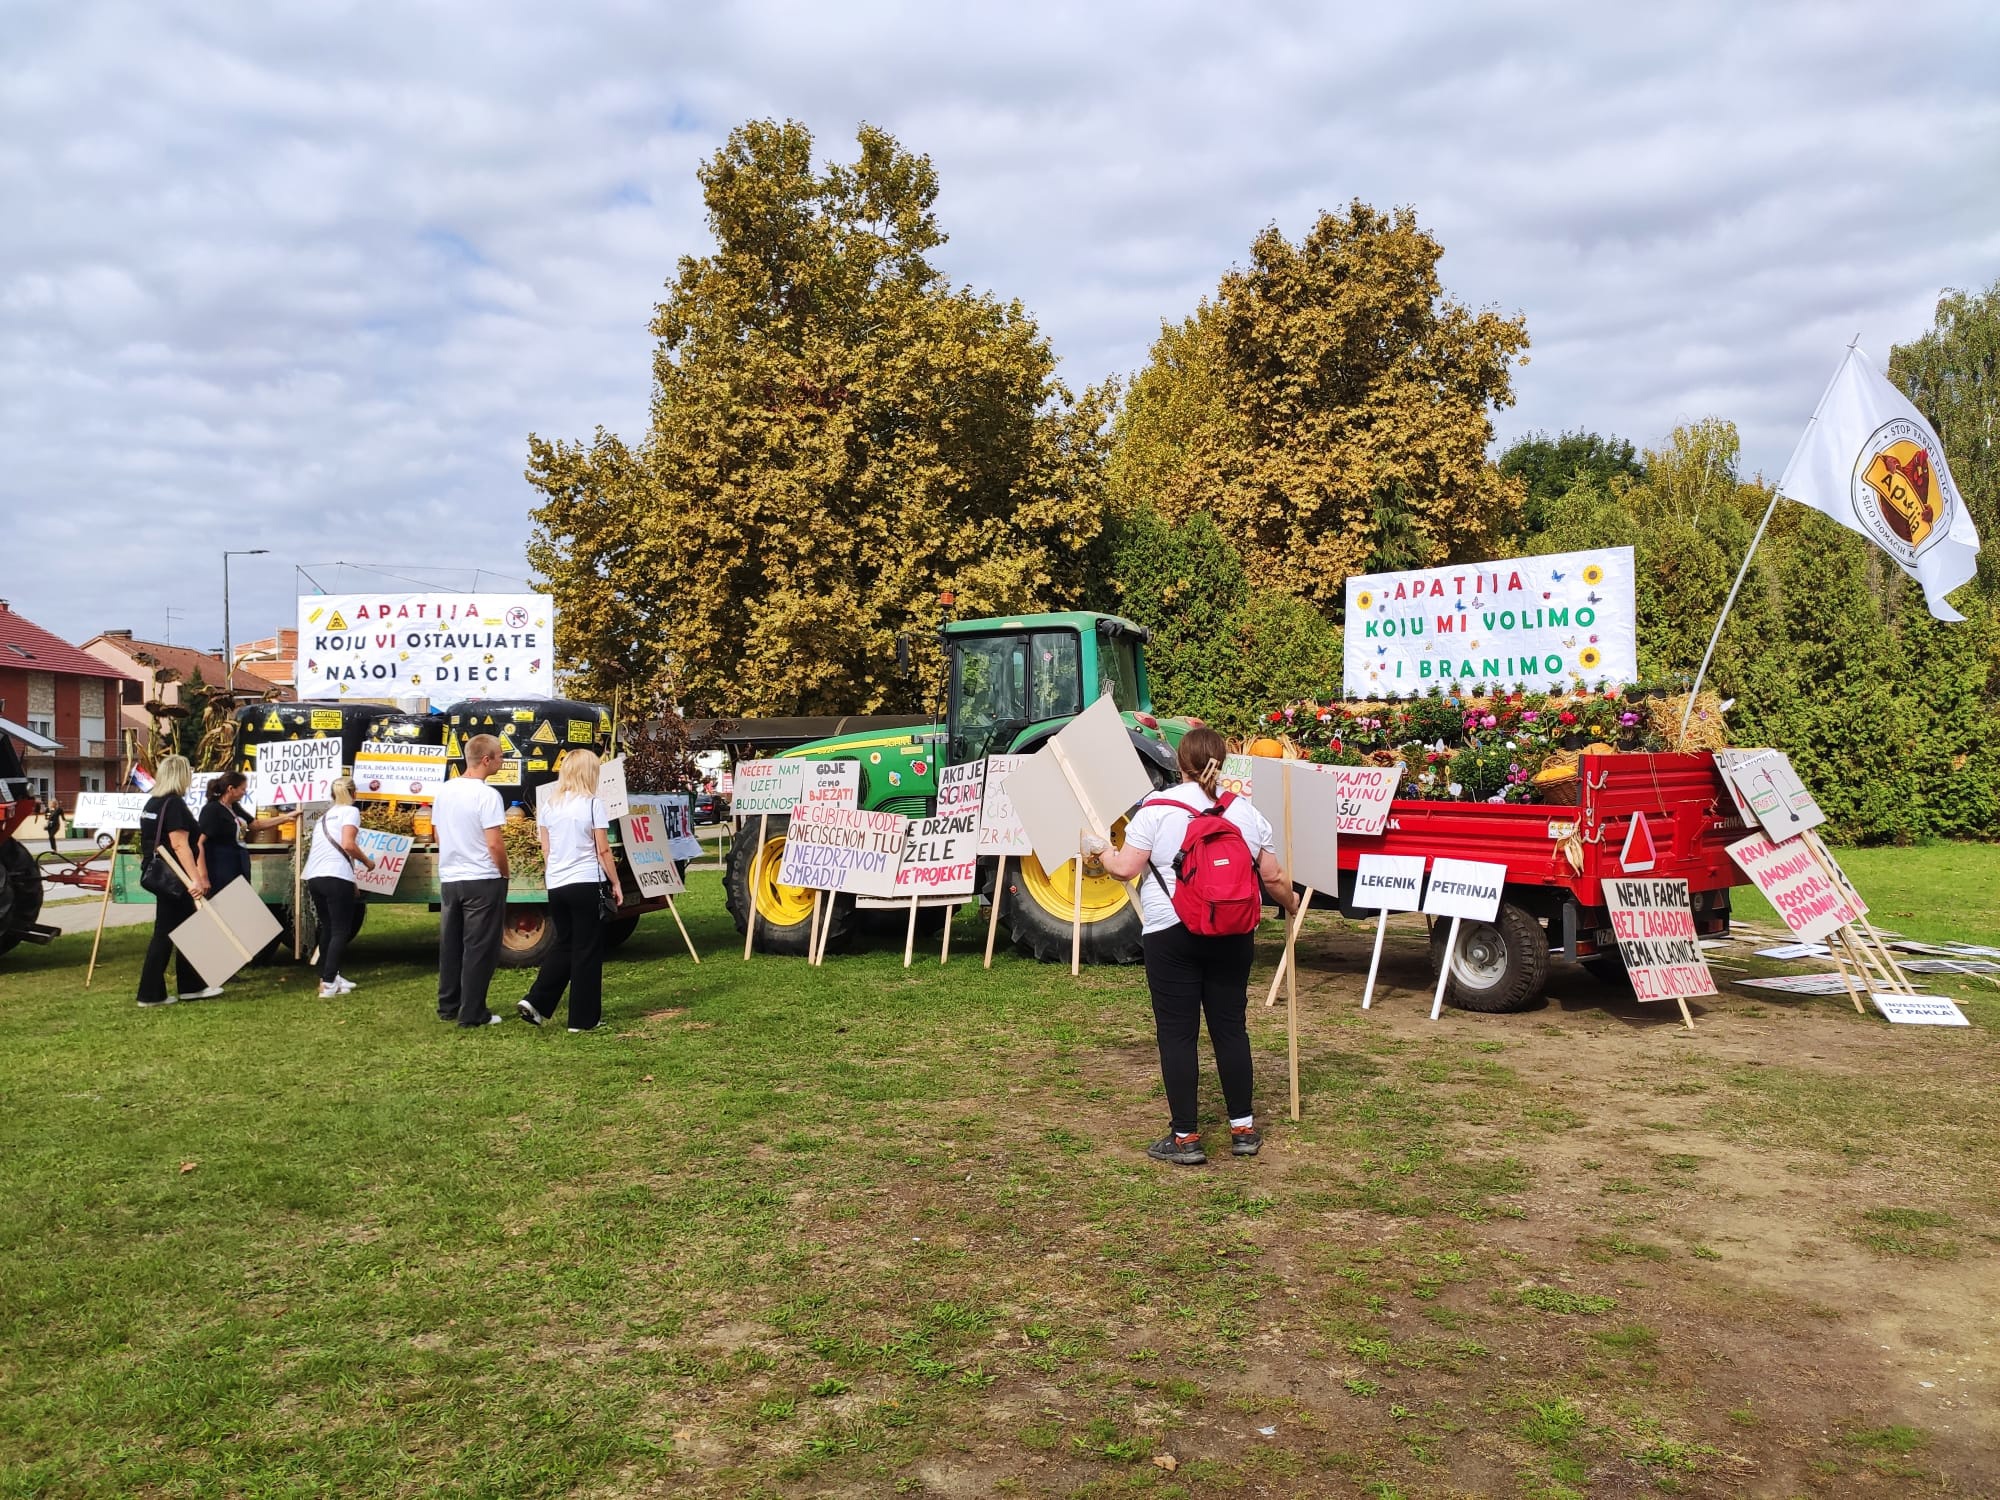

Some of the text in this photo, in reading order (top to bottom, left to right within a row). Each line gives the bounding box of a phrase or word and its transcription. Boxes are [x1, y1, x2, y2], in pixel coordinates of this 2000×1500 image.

[1890, 424, 1911, 436] STOP
[1862, 494, 1876, 518] SELO
[1394, 571, 1523, 600] APATIJA
[357, 603, 479, 620] APATIJA
[1365, 607, 1596, 637] KOJU MI VOLIMO
[316, 633, 536, 651] KOJU VI OSTAVLJATE
[326, 661, 510, 682] NAŠOJ DJECI
[1396, 654, 1563, 679] I BRANIMO
[260, 740, 341, 760] MI HODAMO
[264, 757, 334, 773] UZDIGNUTE
[740, 761, 800, 777] NEĆETE NAM
[816, 762, 846, 775] GDJE
[942, 761, 983, 785] AKO JE
[270, 771, 315, 785] GLAVE
[750, 778, 782, 792] UZETI
[82, 795, 109, 807] NIJE
[273, 786, 287, 803] A
[293, 783, 313, 801] VI
[320, 780, 328, 799] ?
[736, 793, 800, 810] BUDUĆNOST
[809, 786, 854, 801] BJEŽATI
[938, 781, 983, 805] SIGURNO
[792, 805, 810, 821] NE
[812, 806, 863, 828] GUBITKU
[904, 814, 976, 837] E DRŽAVE
[631, 816, 654, 843] NE
[980, 827, 1025, 846] ZRAK
[872, 832, 903, 854] TLU
[904, 840, 956, 863] ŽELE
[379, 856, 404, 873] NE
[784, 843, 887, 873] I NEIZDRŽIVOM
[783, 864, 847, 889] SMRADU!
[1361, 874, 1417, 890] LEKENIK
[1757, 852, 1812, 891] AMONIJAK
[1431, 880, 1497, 900] PETRINJA
[1615, 881, 1689, 907] NEMA FARME
[1775, 874, 1831, 911] FOSFOR U
[1786, 892, 1838, 930] OTPADNIM
[1612, 911, 1640, 939] BEZ
[1619, 940, 1700, 968] NEMA KLAONICE
[1630, 970, 1659, 999] BEZ
[1884, 1002, 1951, 1010] INVESTITORI
